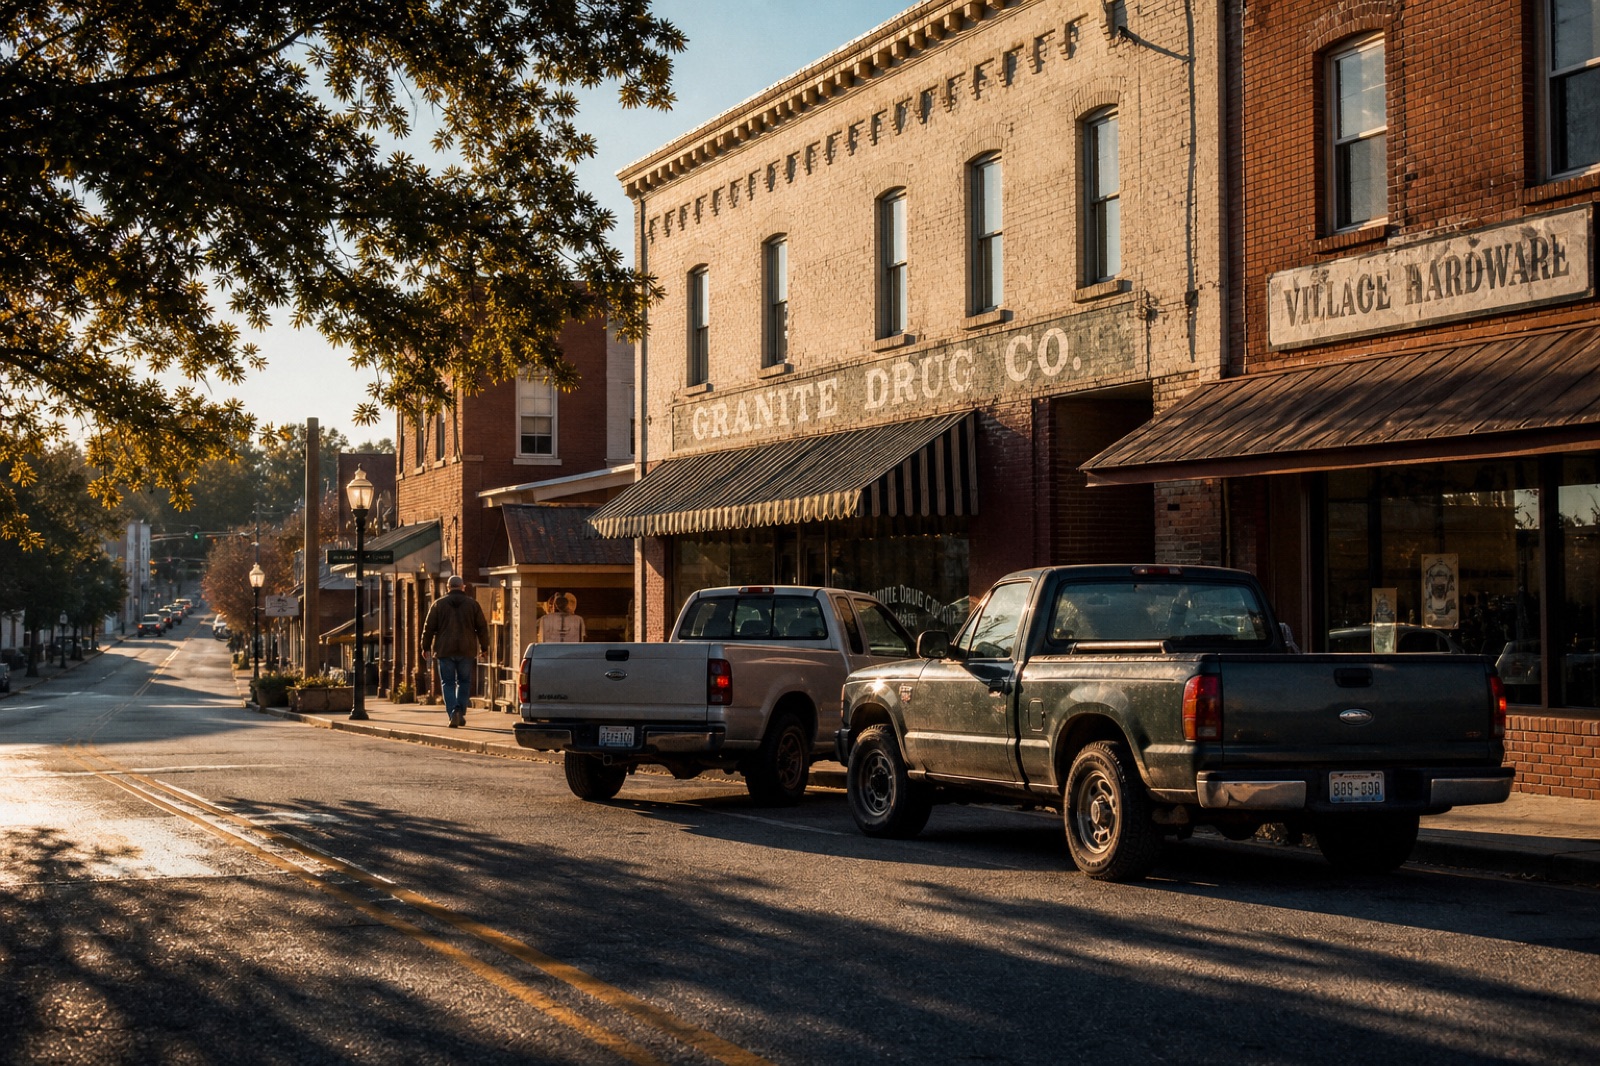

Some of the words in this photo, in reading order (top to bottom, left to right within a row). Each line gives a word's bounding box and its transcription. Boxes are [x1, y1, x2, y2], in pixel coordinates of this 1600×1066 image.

[1283, 269, 1392, 327] VILLAGE
[1404, 233, 1570, 305] HARDWARE
[692, 378, 838, 440] GRANITE
[864, 347, 976, 410] DRUG
[1005, 327, 1082, 383] CO.
